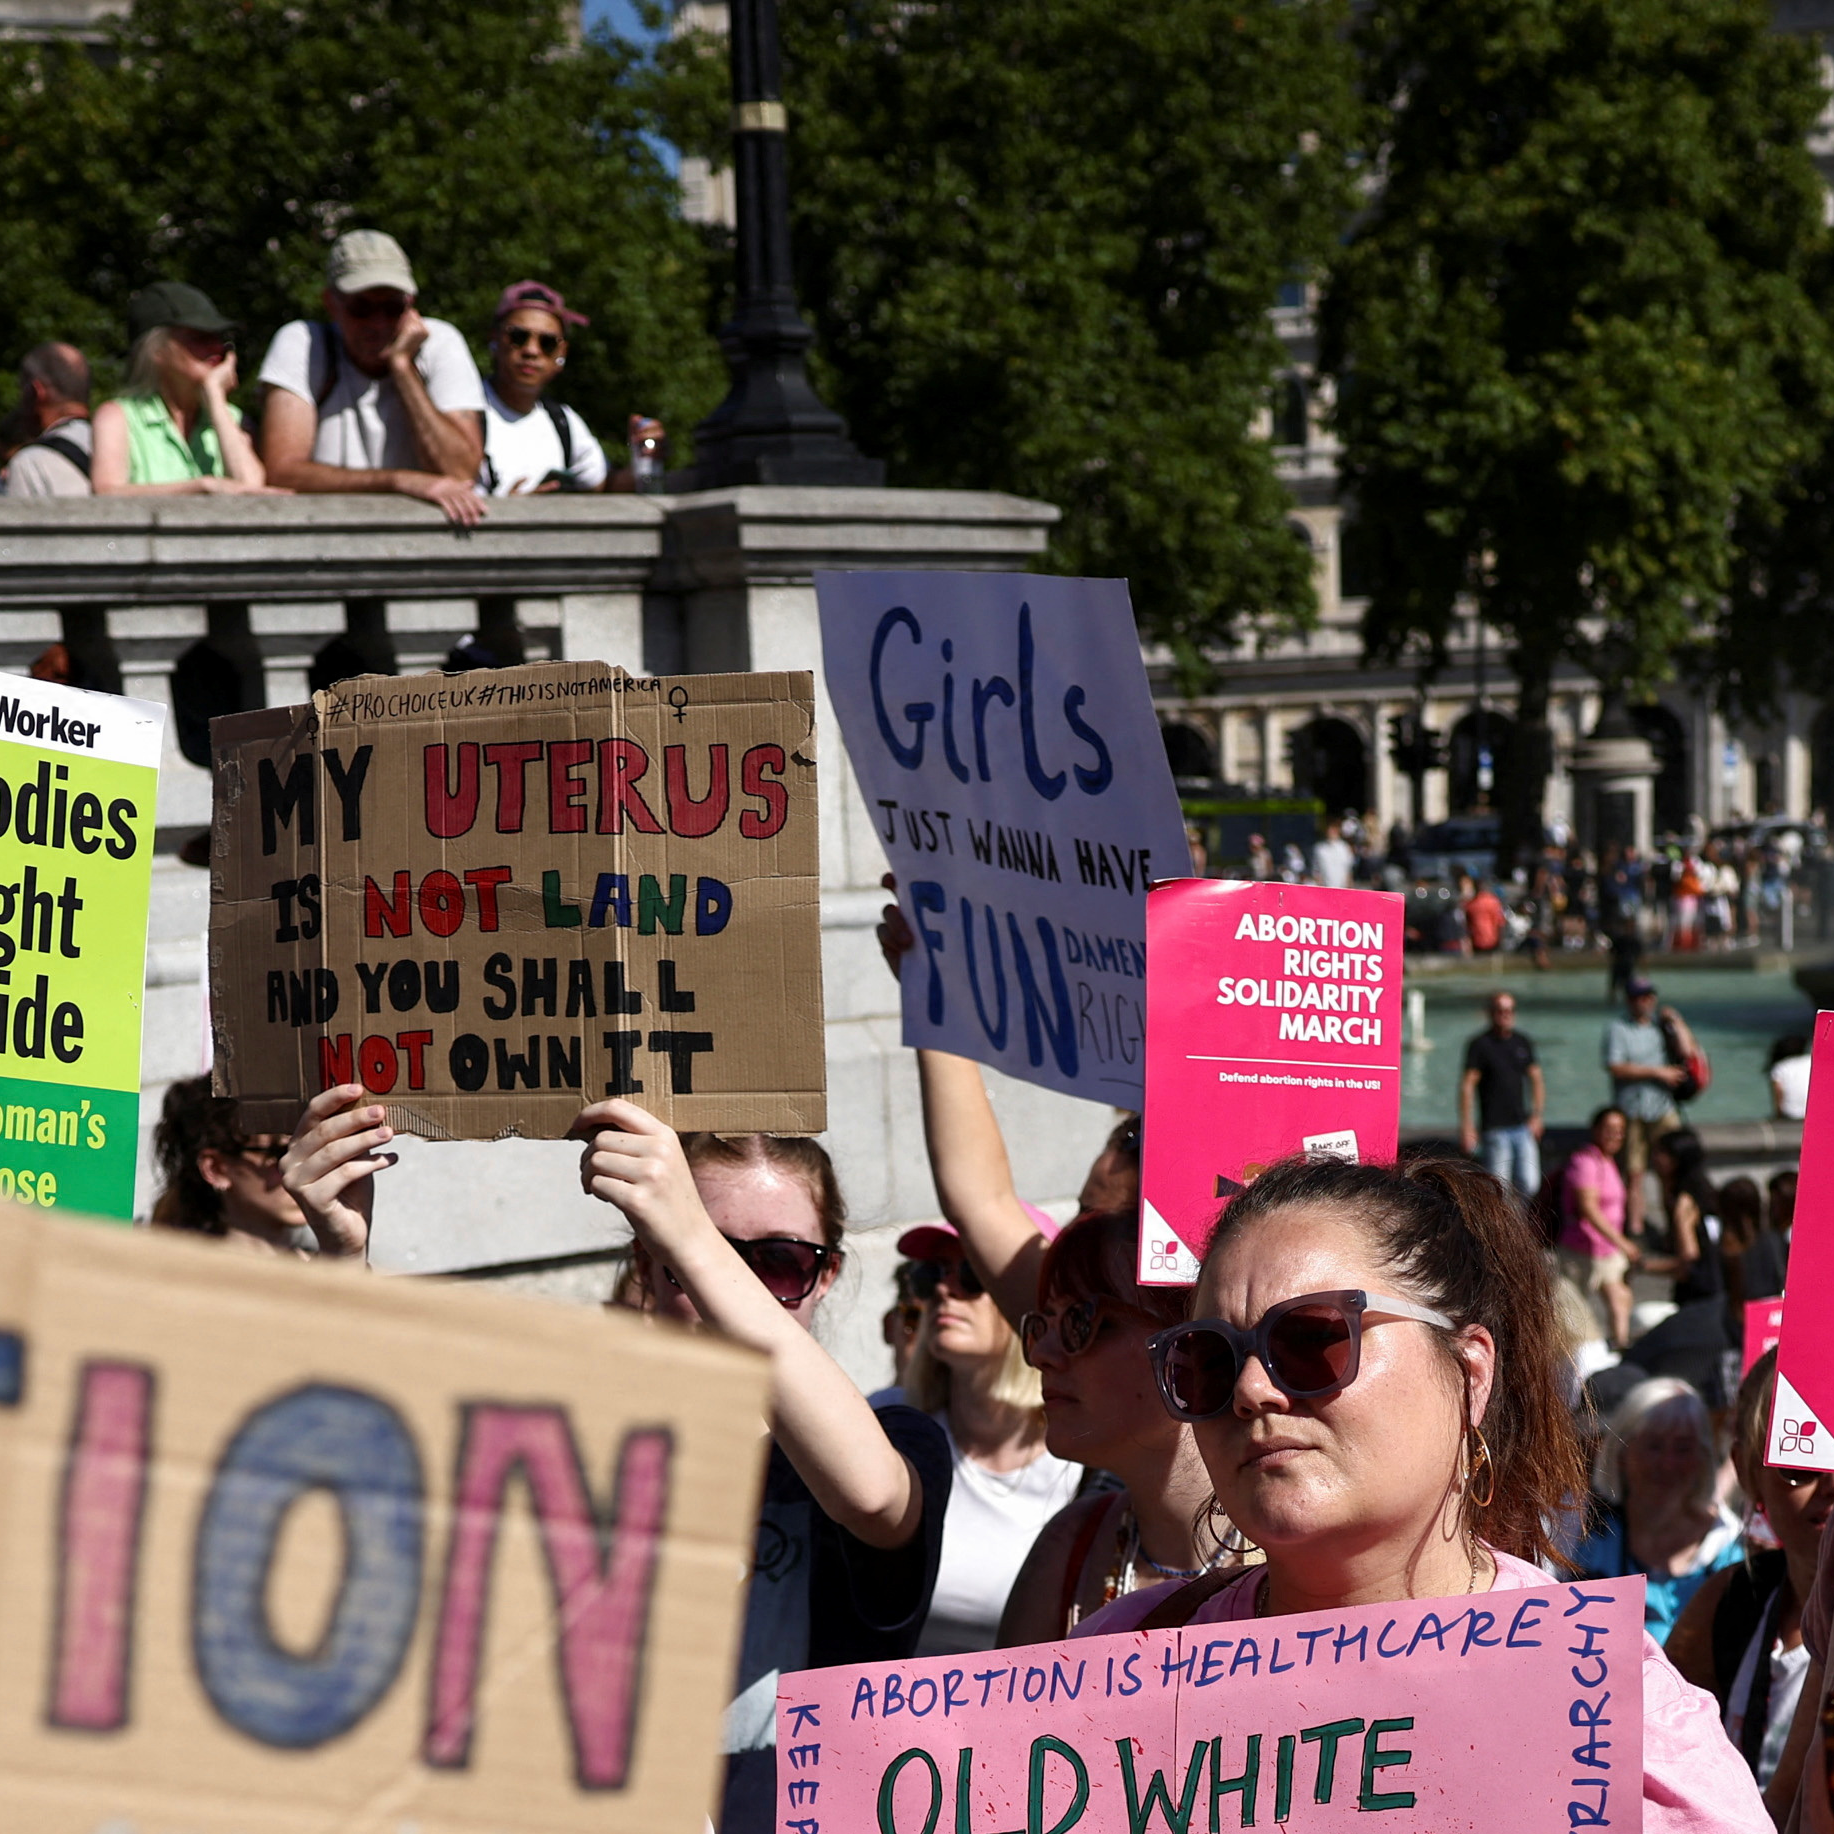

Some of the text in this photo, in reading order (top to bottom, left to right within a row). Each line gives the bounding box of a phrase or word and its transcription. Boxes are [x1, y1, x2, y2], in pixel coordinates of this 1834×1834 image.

[870, 601, 1113, 801] Girls
[258, 738, 788, 856] MY UTERUS
[877, 799, 1152, 897] JUST WANNA HAVE
[270, 866, 732, 942] IS NOT LAND
[1234, 912, 1383, 950] ABORTION
[1063, 926, 1146, 980] DAMEN
[1283, 948, 1383, 982] RIGHTS
[268, 952, 696, 1027] AND YOU SHALL
[1078, 982, 1146, 1065] RIG
[1216, 977, 1384, 1014] SOLIDARITY
[319, 1030, 713, 1095] NOT OWN IT
[1278, 1013, 1381, 1046] MARCH
[1219, 1072, 1381, 1090] Defend abortion rights in the US!
[852, 1598, 1550, 1720] ABORTION IS HEALTHCARE
